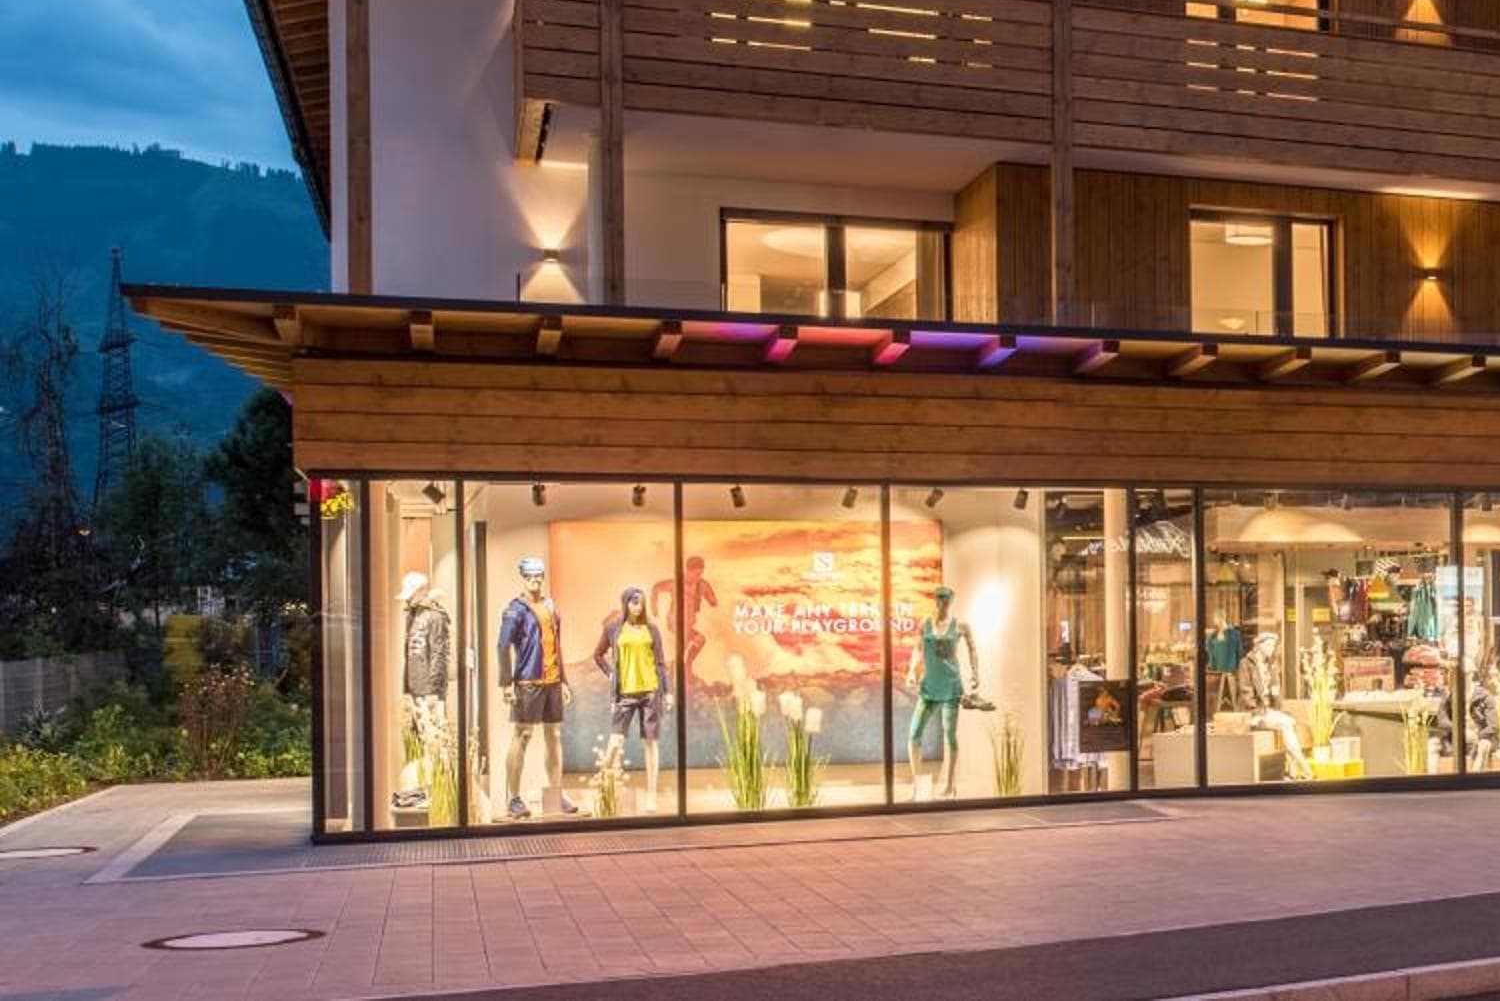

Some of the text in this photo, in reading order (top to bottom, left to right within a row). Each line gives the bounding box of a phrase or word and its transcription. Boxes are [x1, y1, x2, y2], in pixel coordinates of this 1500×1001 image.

[735, 602, 784, 619] MAKE
[793, 602, 832, 618] ANY
[734, 618, 784, 634] YOUR
